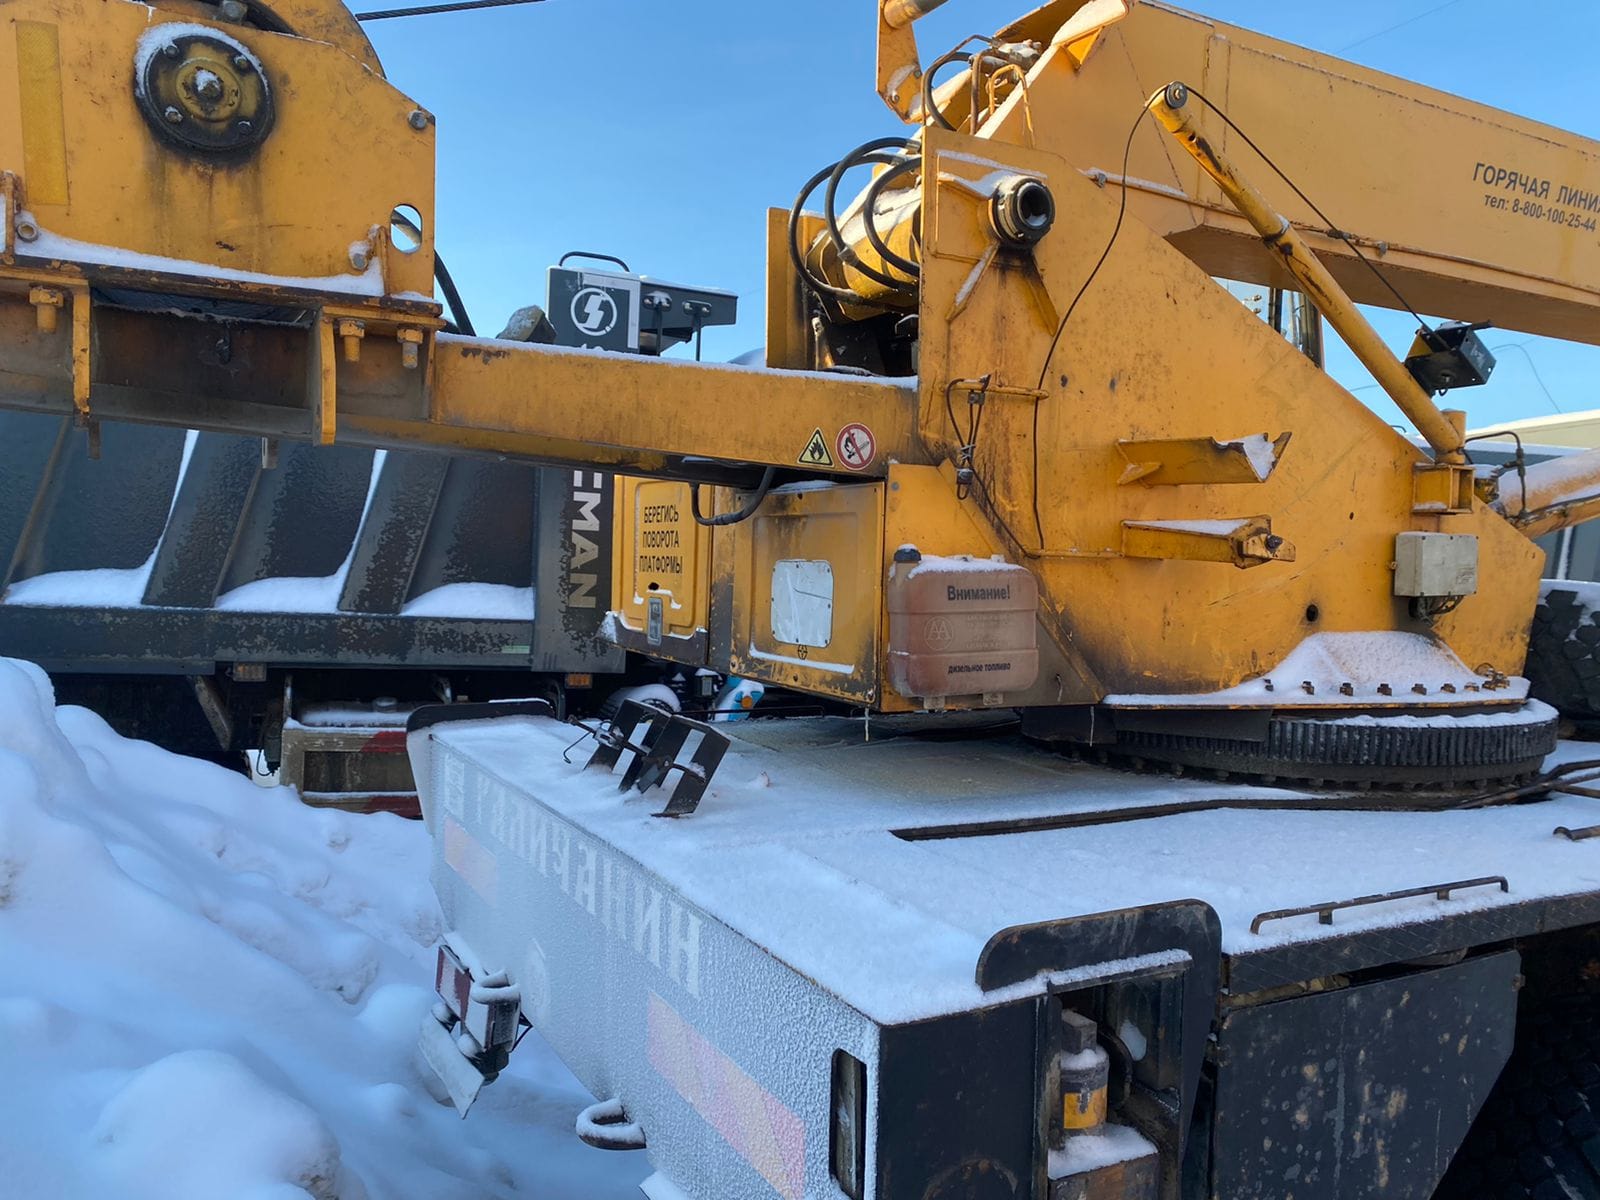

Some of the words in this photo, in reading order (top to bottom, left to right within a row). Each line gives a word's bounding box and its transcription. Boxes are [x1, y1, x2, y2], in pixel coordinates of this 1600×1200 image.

[1473, 162, 1551, 200] ГОРЯЧАЯ
[1556, 185, 1600, 214] ЛИНИ
[1484, 194, 1509, 211] тел:
[1512, 198, 1597, 232] 8-800-100-25-44
[643, 504, 680, 523] БЕРЕГИСЬ
[642, 531, 680, 548] ПОВОРОТА
[639, 555, 683, 574] ПЛАТФОРМЫ
[947, 584, 1010, 601] Внимание!
[948, 664, 983, 674] дизельное
[984, 662, 1011, 671] топливо
